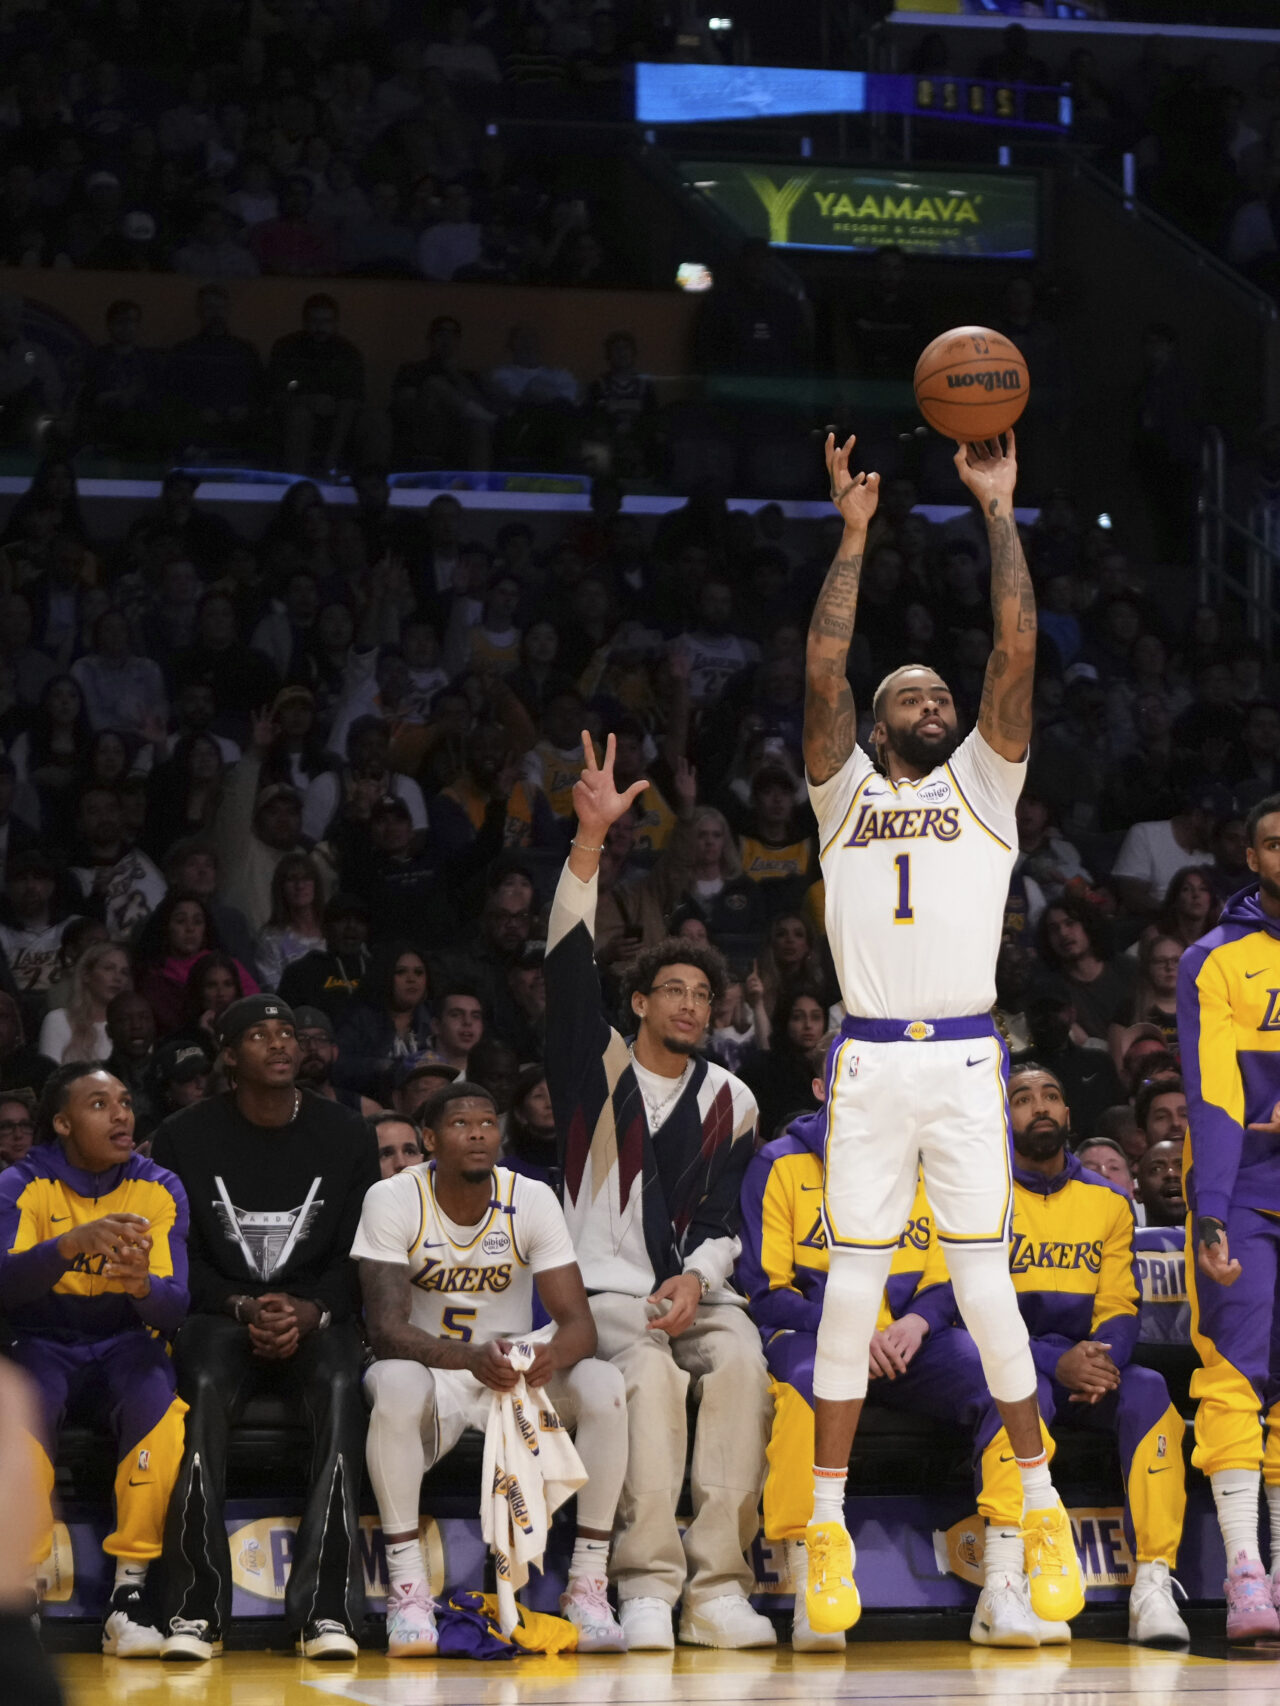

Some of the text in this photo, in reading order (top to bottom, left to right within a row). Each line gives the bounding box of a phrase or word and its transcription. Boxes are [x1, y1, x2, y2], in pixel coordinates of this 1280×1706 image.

[946, 369, 1021, 392] Wilson
[842, 803, 962, 848] LAKERS
[893, 852, 914, 924] 1
[483, 1233, 510, 1248] bibigo
[1010, 1232, 1103, 1274] LAKERS
[410, 1257, 513, 1293] LAKERS
[440, 1306, 477, 1343] 5
[508, 1480, 529, 1518] PRIME
